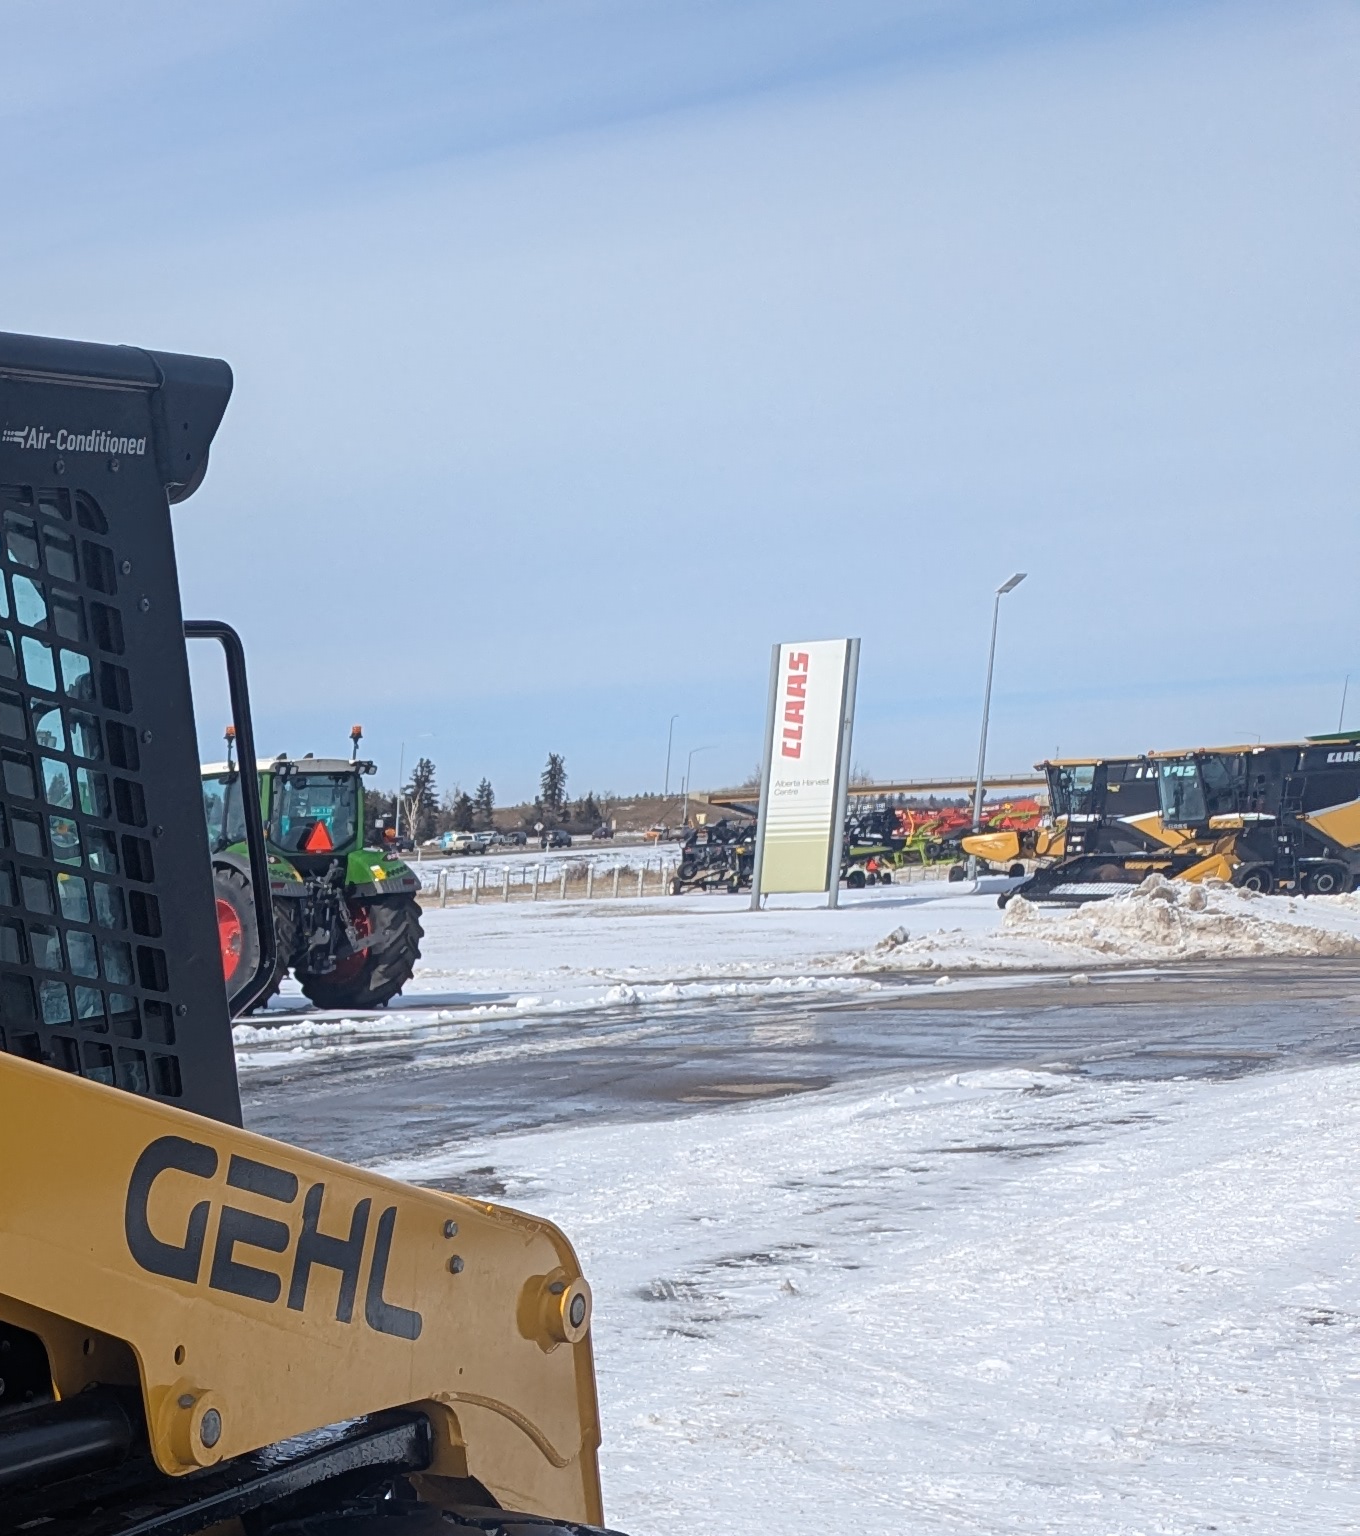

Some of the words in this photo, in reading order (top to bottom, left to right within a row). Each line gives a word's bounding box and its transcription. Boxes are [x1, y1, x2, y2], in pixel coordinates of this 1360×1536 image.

[26, 425, 147, 455] Air-Conditioned
[781, 652, 809, 759] CLAAS
[773, 788, 798, 796] Centre
[802, 778, 830, 786] Harvest
[125, 1135, 423, 1341] GEHL
